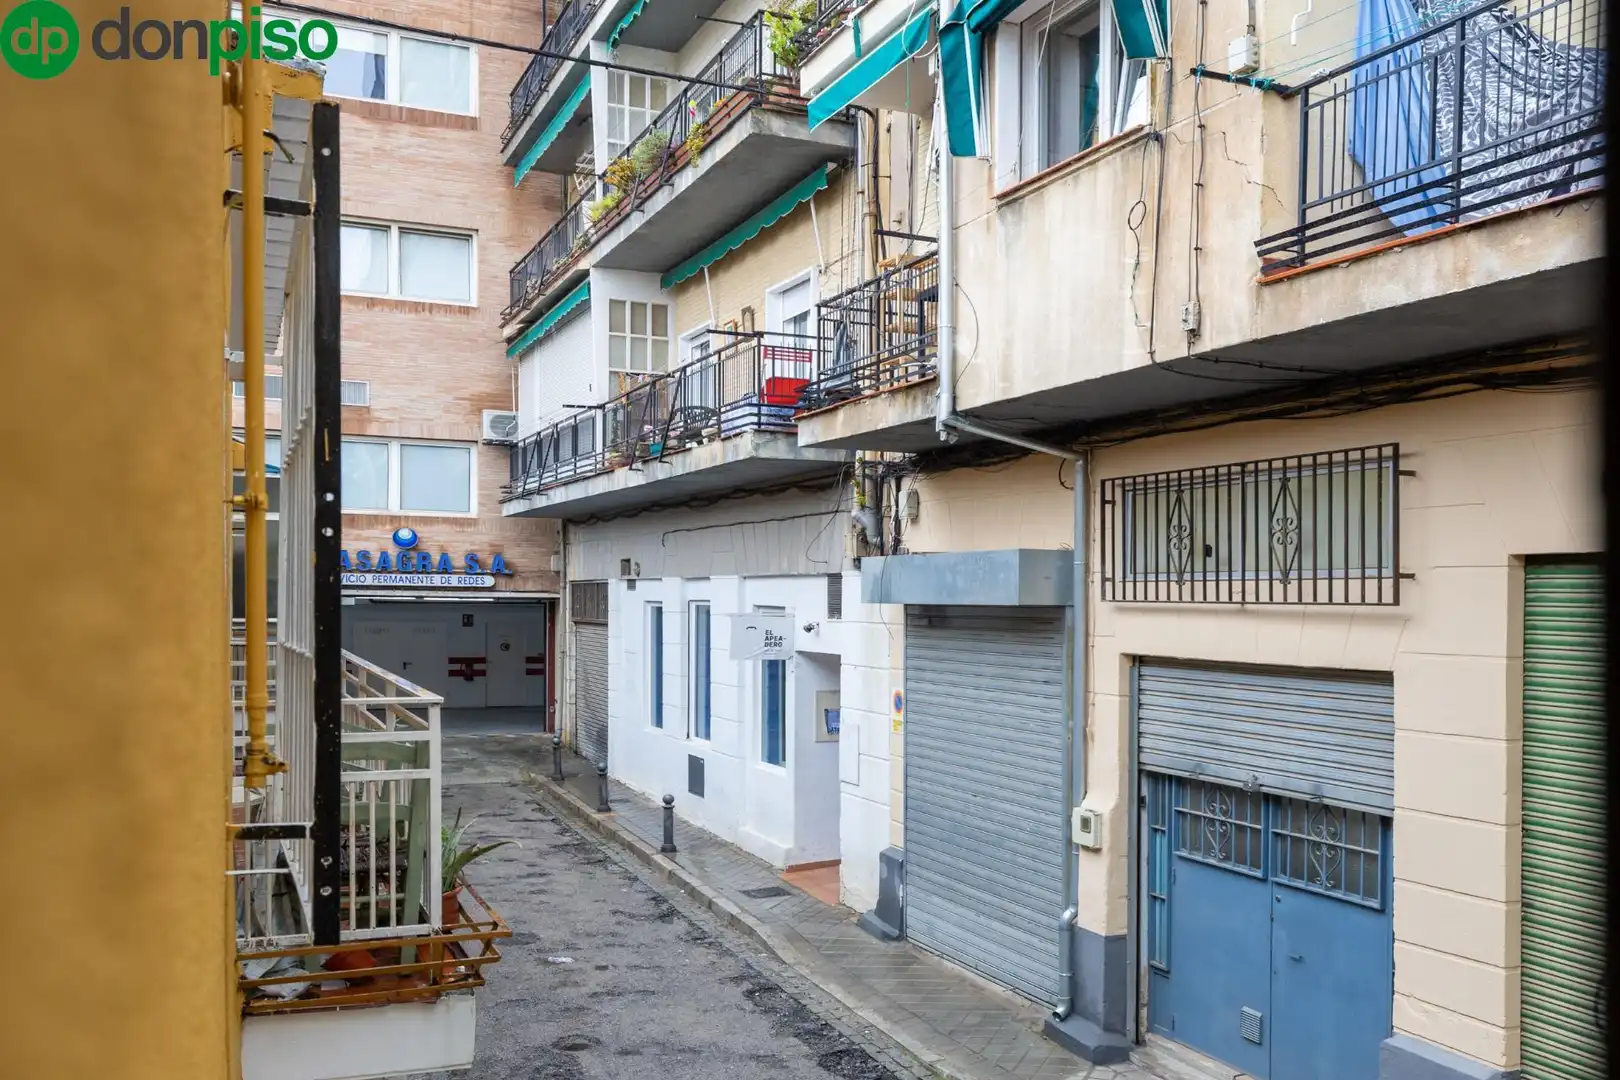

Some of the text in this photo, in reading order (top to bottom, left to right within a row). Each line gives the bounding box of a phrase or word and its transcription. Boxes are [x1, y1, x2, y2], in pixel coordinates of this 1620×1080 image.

[372, 574, 435, 585] PERMANENTE
[440, 576, 453, 585] DE
[457, 576, 486, 586] REDES
